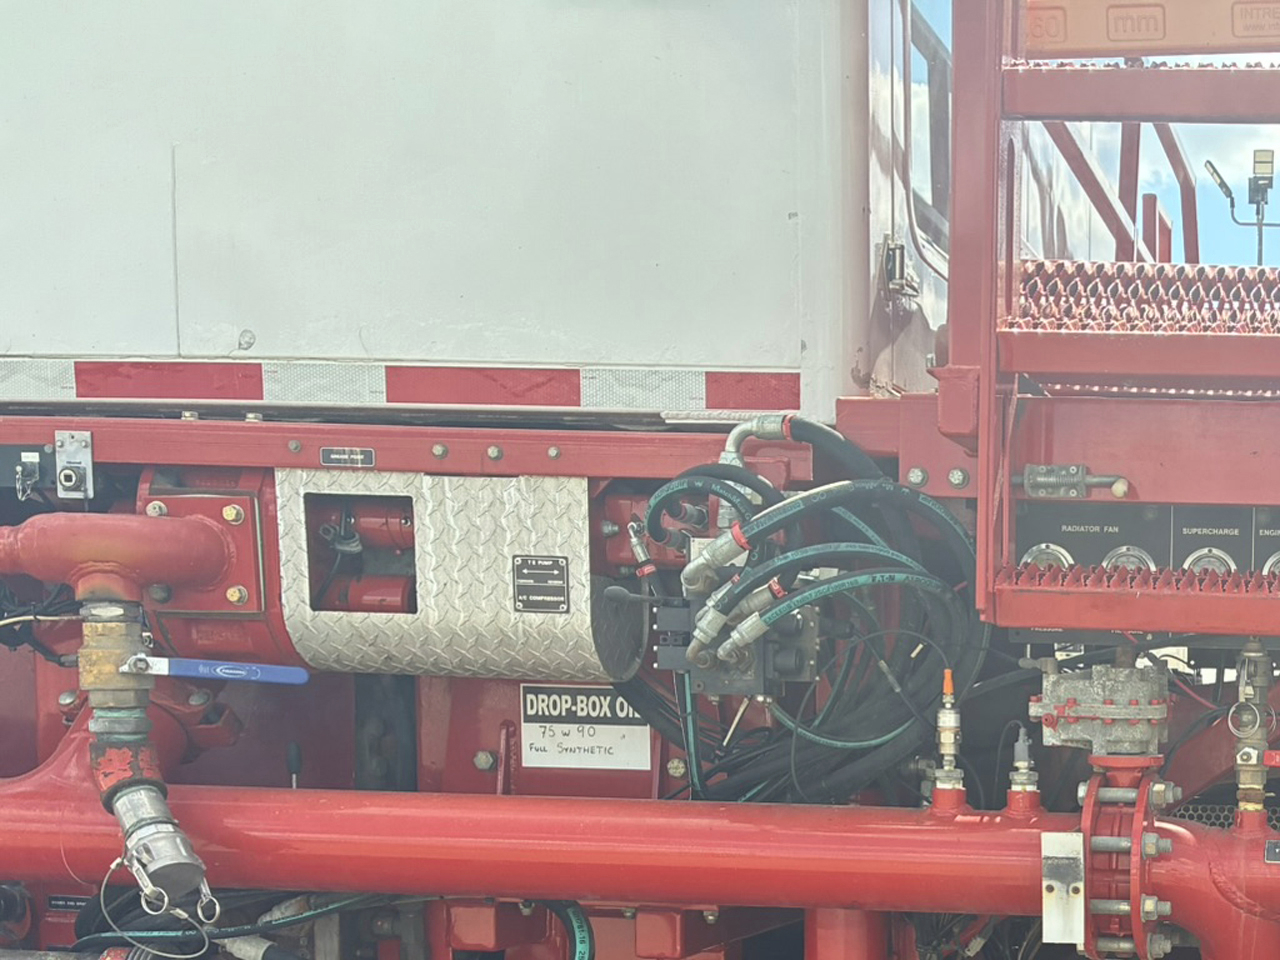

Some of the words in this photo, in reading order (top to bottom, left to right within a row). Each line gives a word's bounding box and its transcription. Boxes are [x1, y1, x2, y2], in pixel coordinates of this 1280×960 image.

[1113, 13, 1159, 33] mm
[1182, 527, 1240, 536] SUPERCHARGE
[526, 693, 612, 717] DROP-BOX
[539, 725, 556, 738] 75
[576, 725, 596, 738] 90
